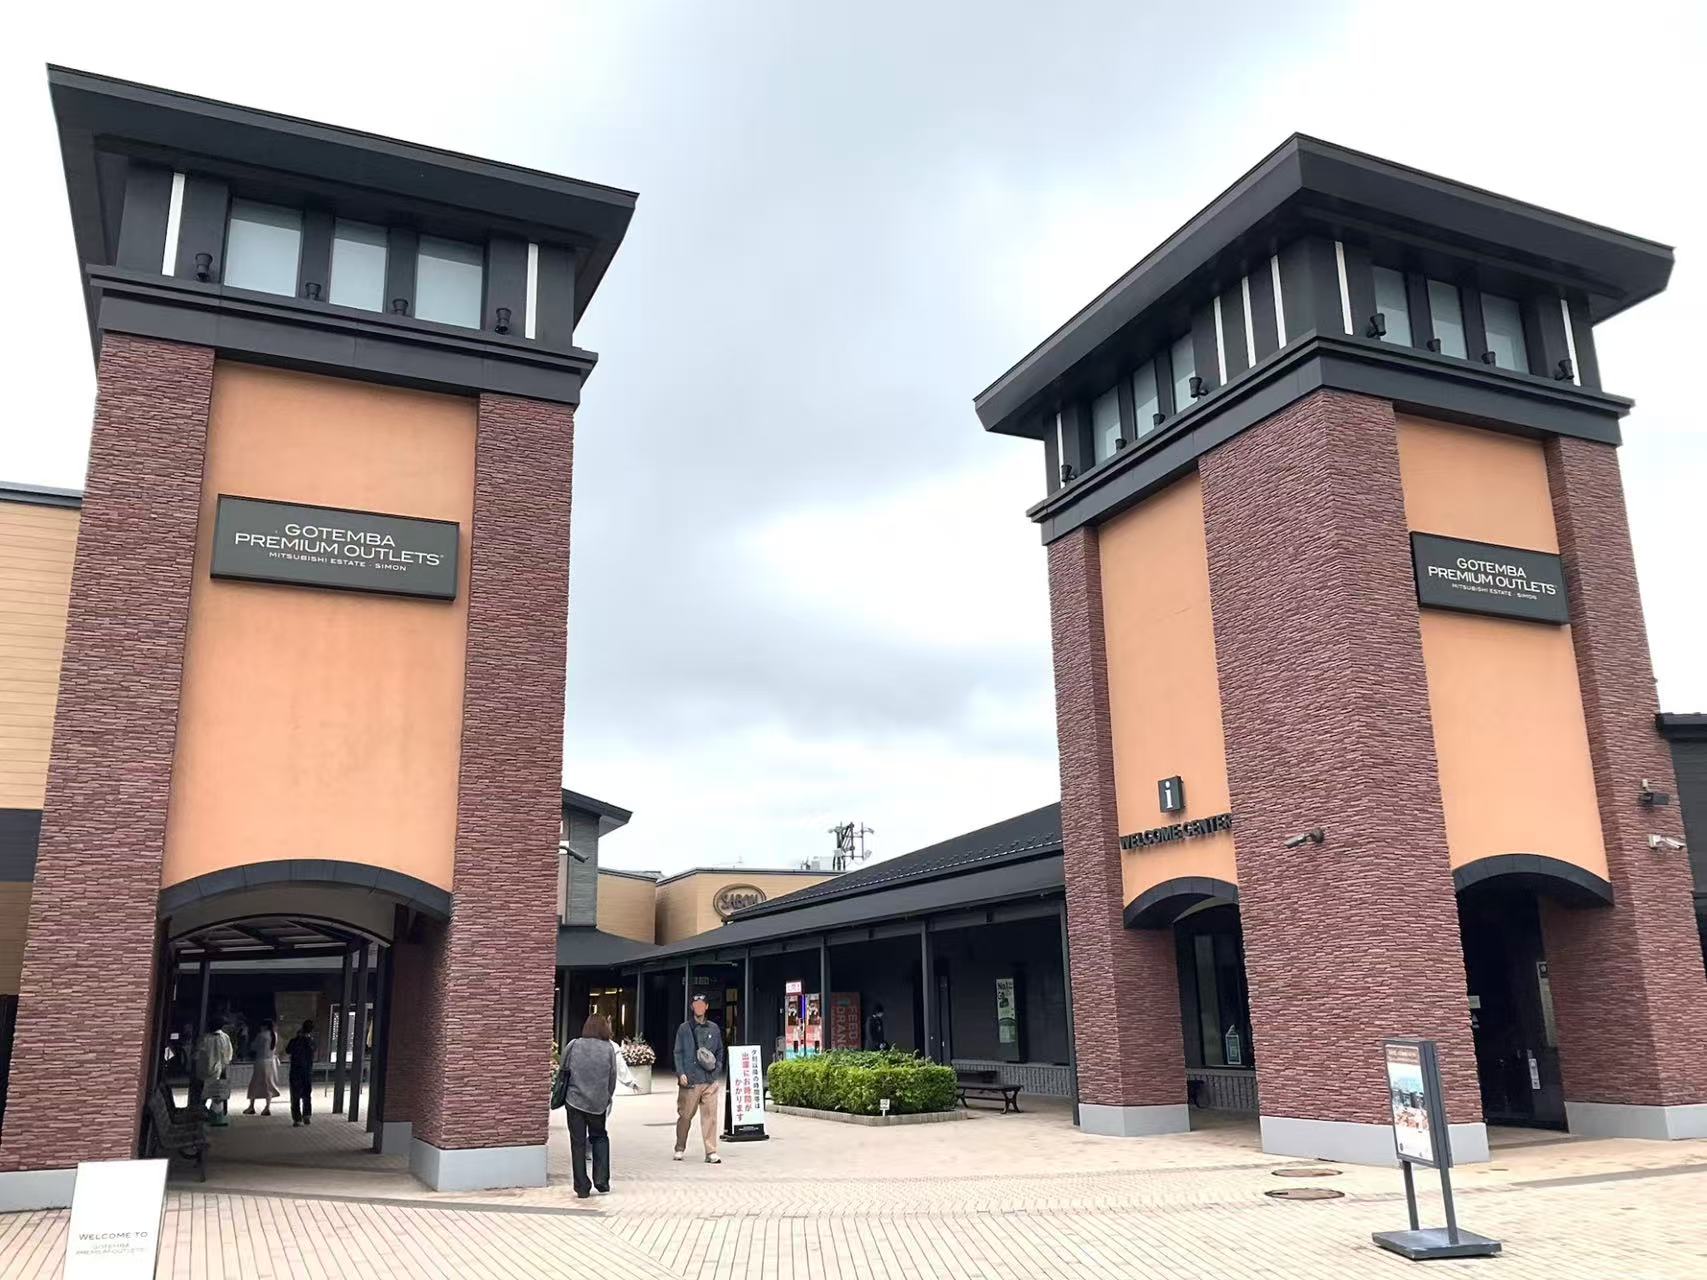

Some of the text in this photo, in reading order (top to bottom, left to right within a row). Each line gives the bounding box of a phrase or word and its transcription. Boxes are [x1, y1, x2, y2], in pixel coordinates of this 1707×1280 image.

[284, 523, 396, 548] GOTEMBA
[234, 532, 440, 566] PREMIUM OUTLETS
[269, 551, 407, 571] MITSUBISHI ESTATE SIMON
[1456, 557, 1527, 578] GOTEMBA
[1427, 565, 1557, 595] PREMIUM OUTLETS
[1451, 583, 1538, 600] MITSUBISHI ESTATE SIMON
[1119, 812, 1232, 850] WELCOME CENTER
[79, 1232, 132, 1240] WELCOME
